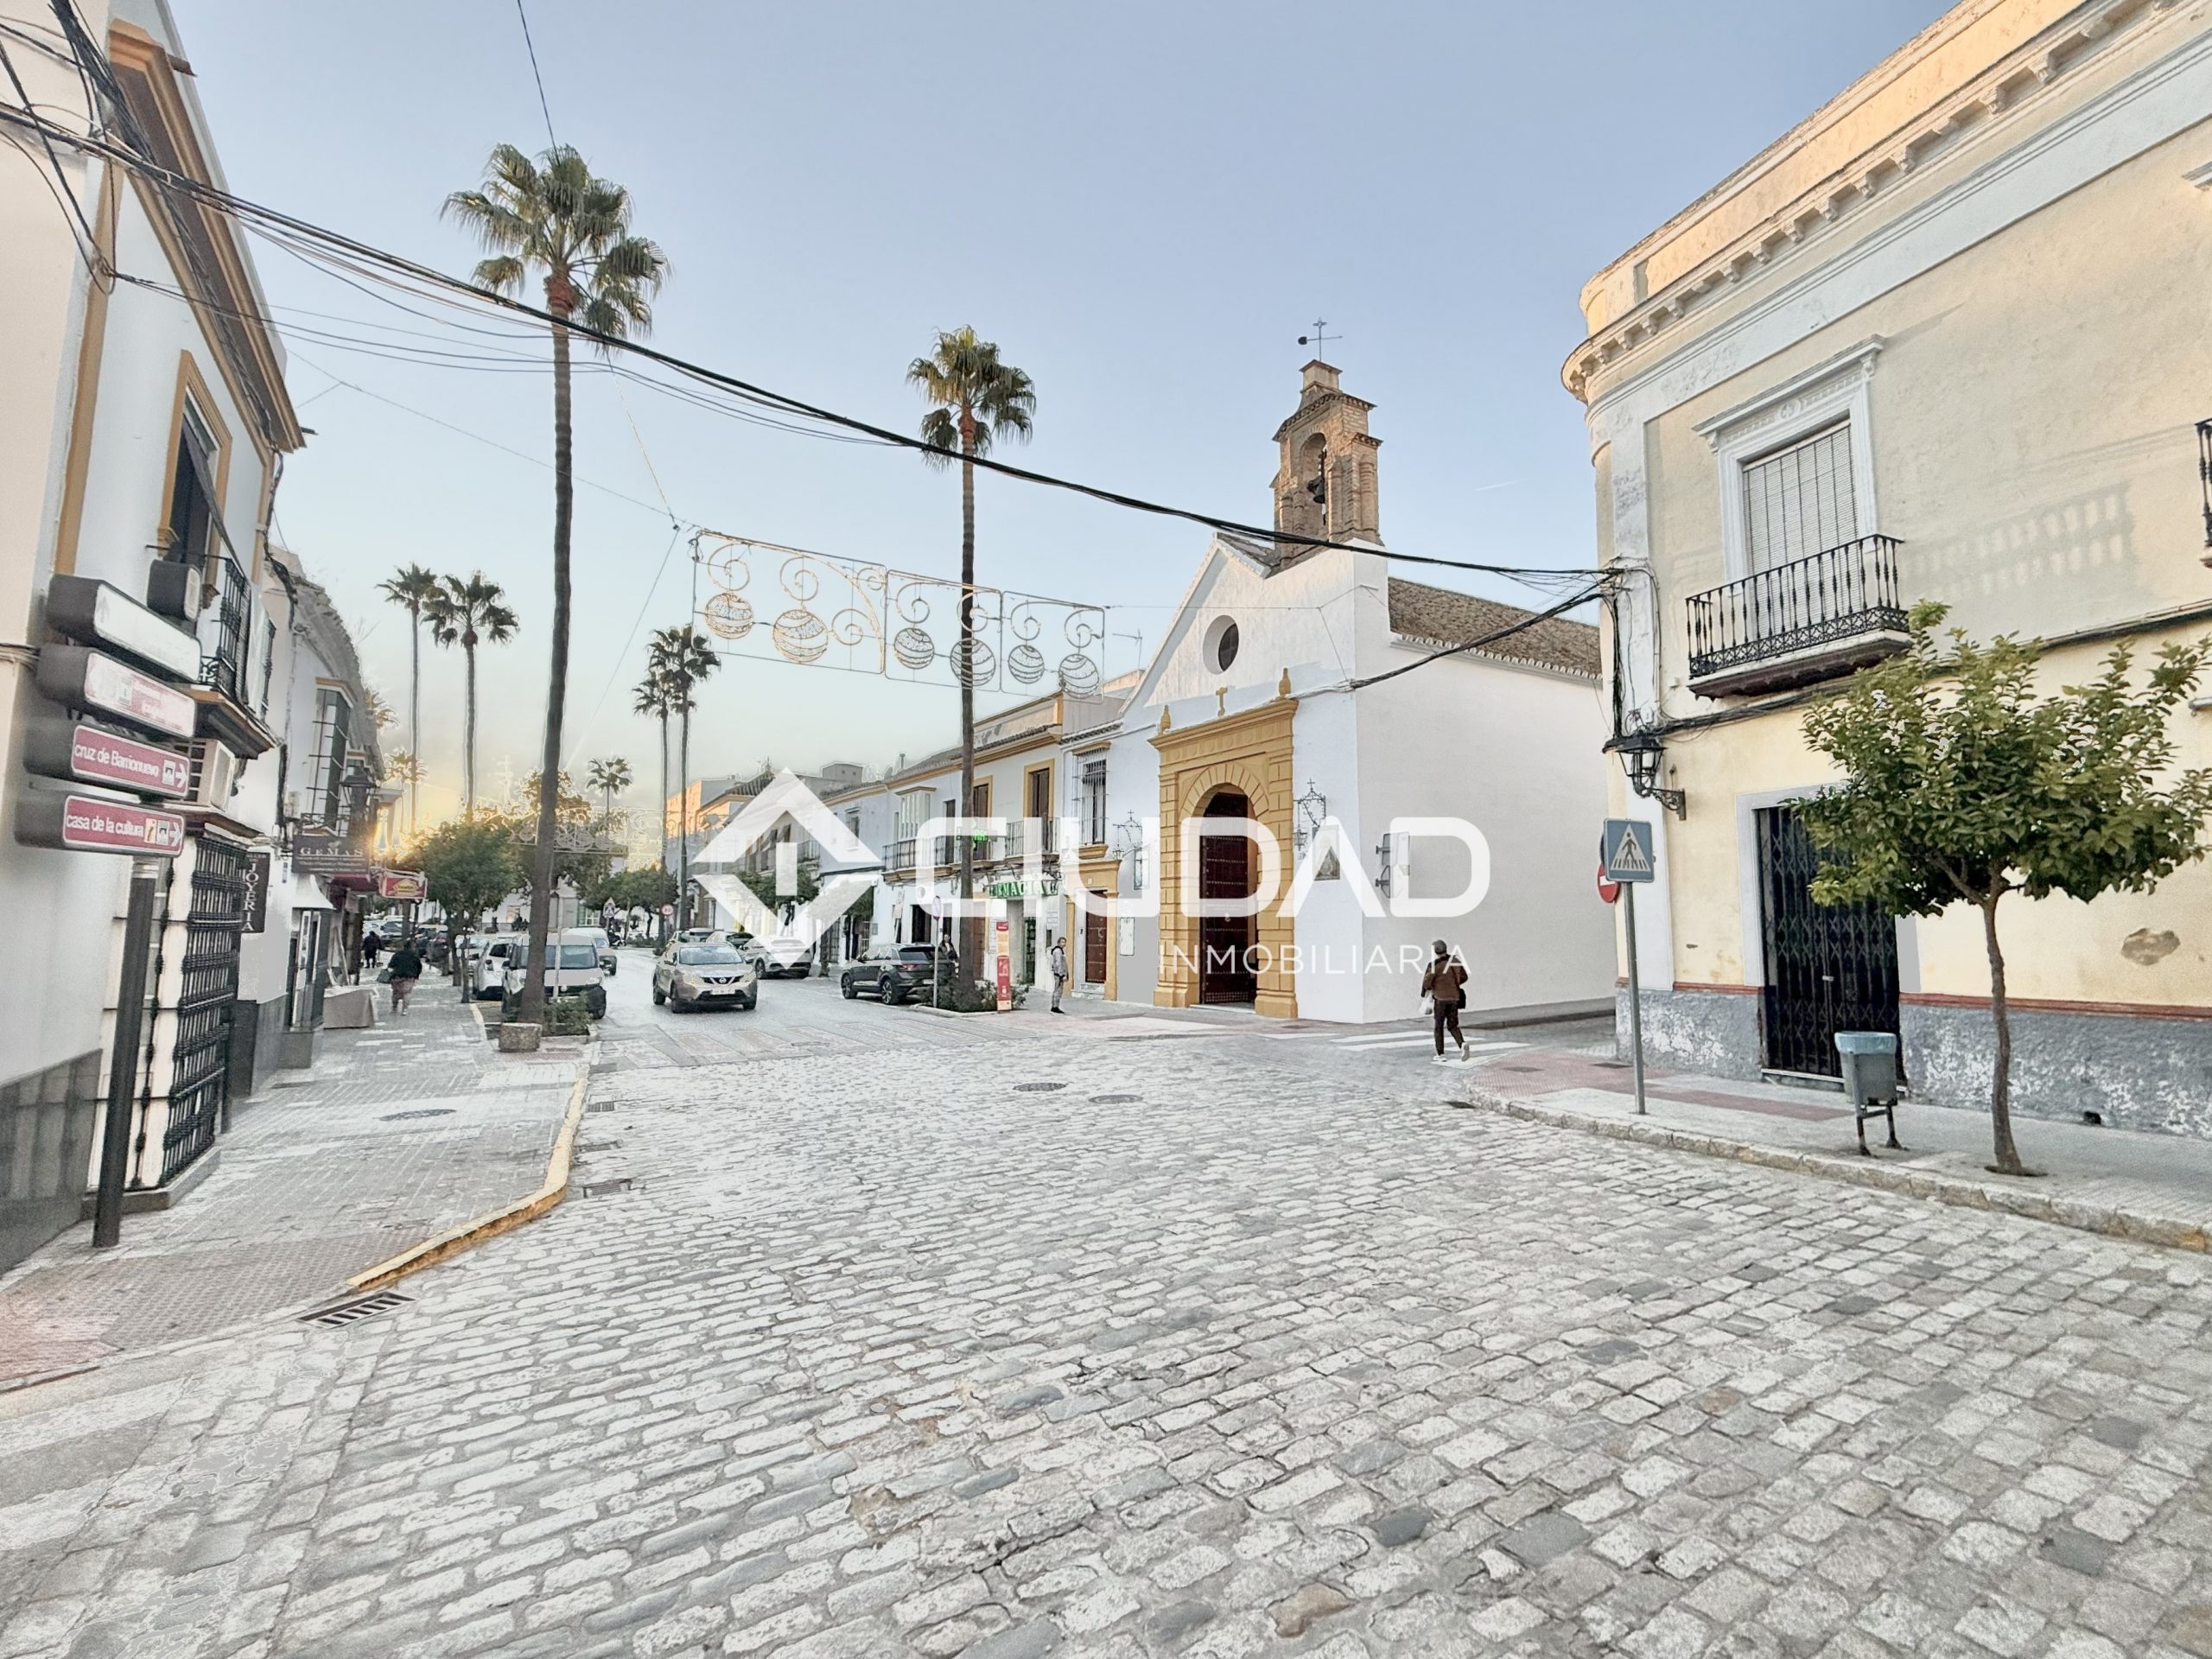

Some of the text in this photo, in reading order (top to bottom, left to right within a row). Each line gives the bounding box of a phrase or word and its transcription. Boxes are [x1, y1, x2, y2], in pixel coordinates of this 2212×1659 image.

[74, 744, 97, 761] cruz
[97, 747, 110, 765] de
[66, 814, 143, 837] casa de la cultura
[242, 862, 259, 931] JOYERIA
